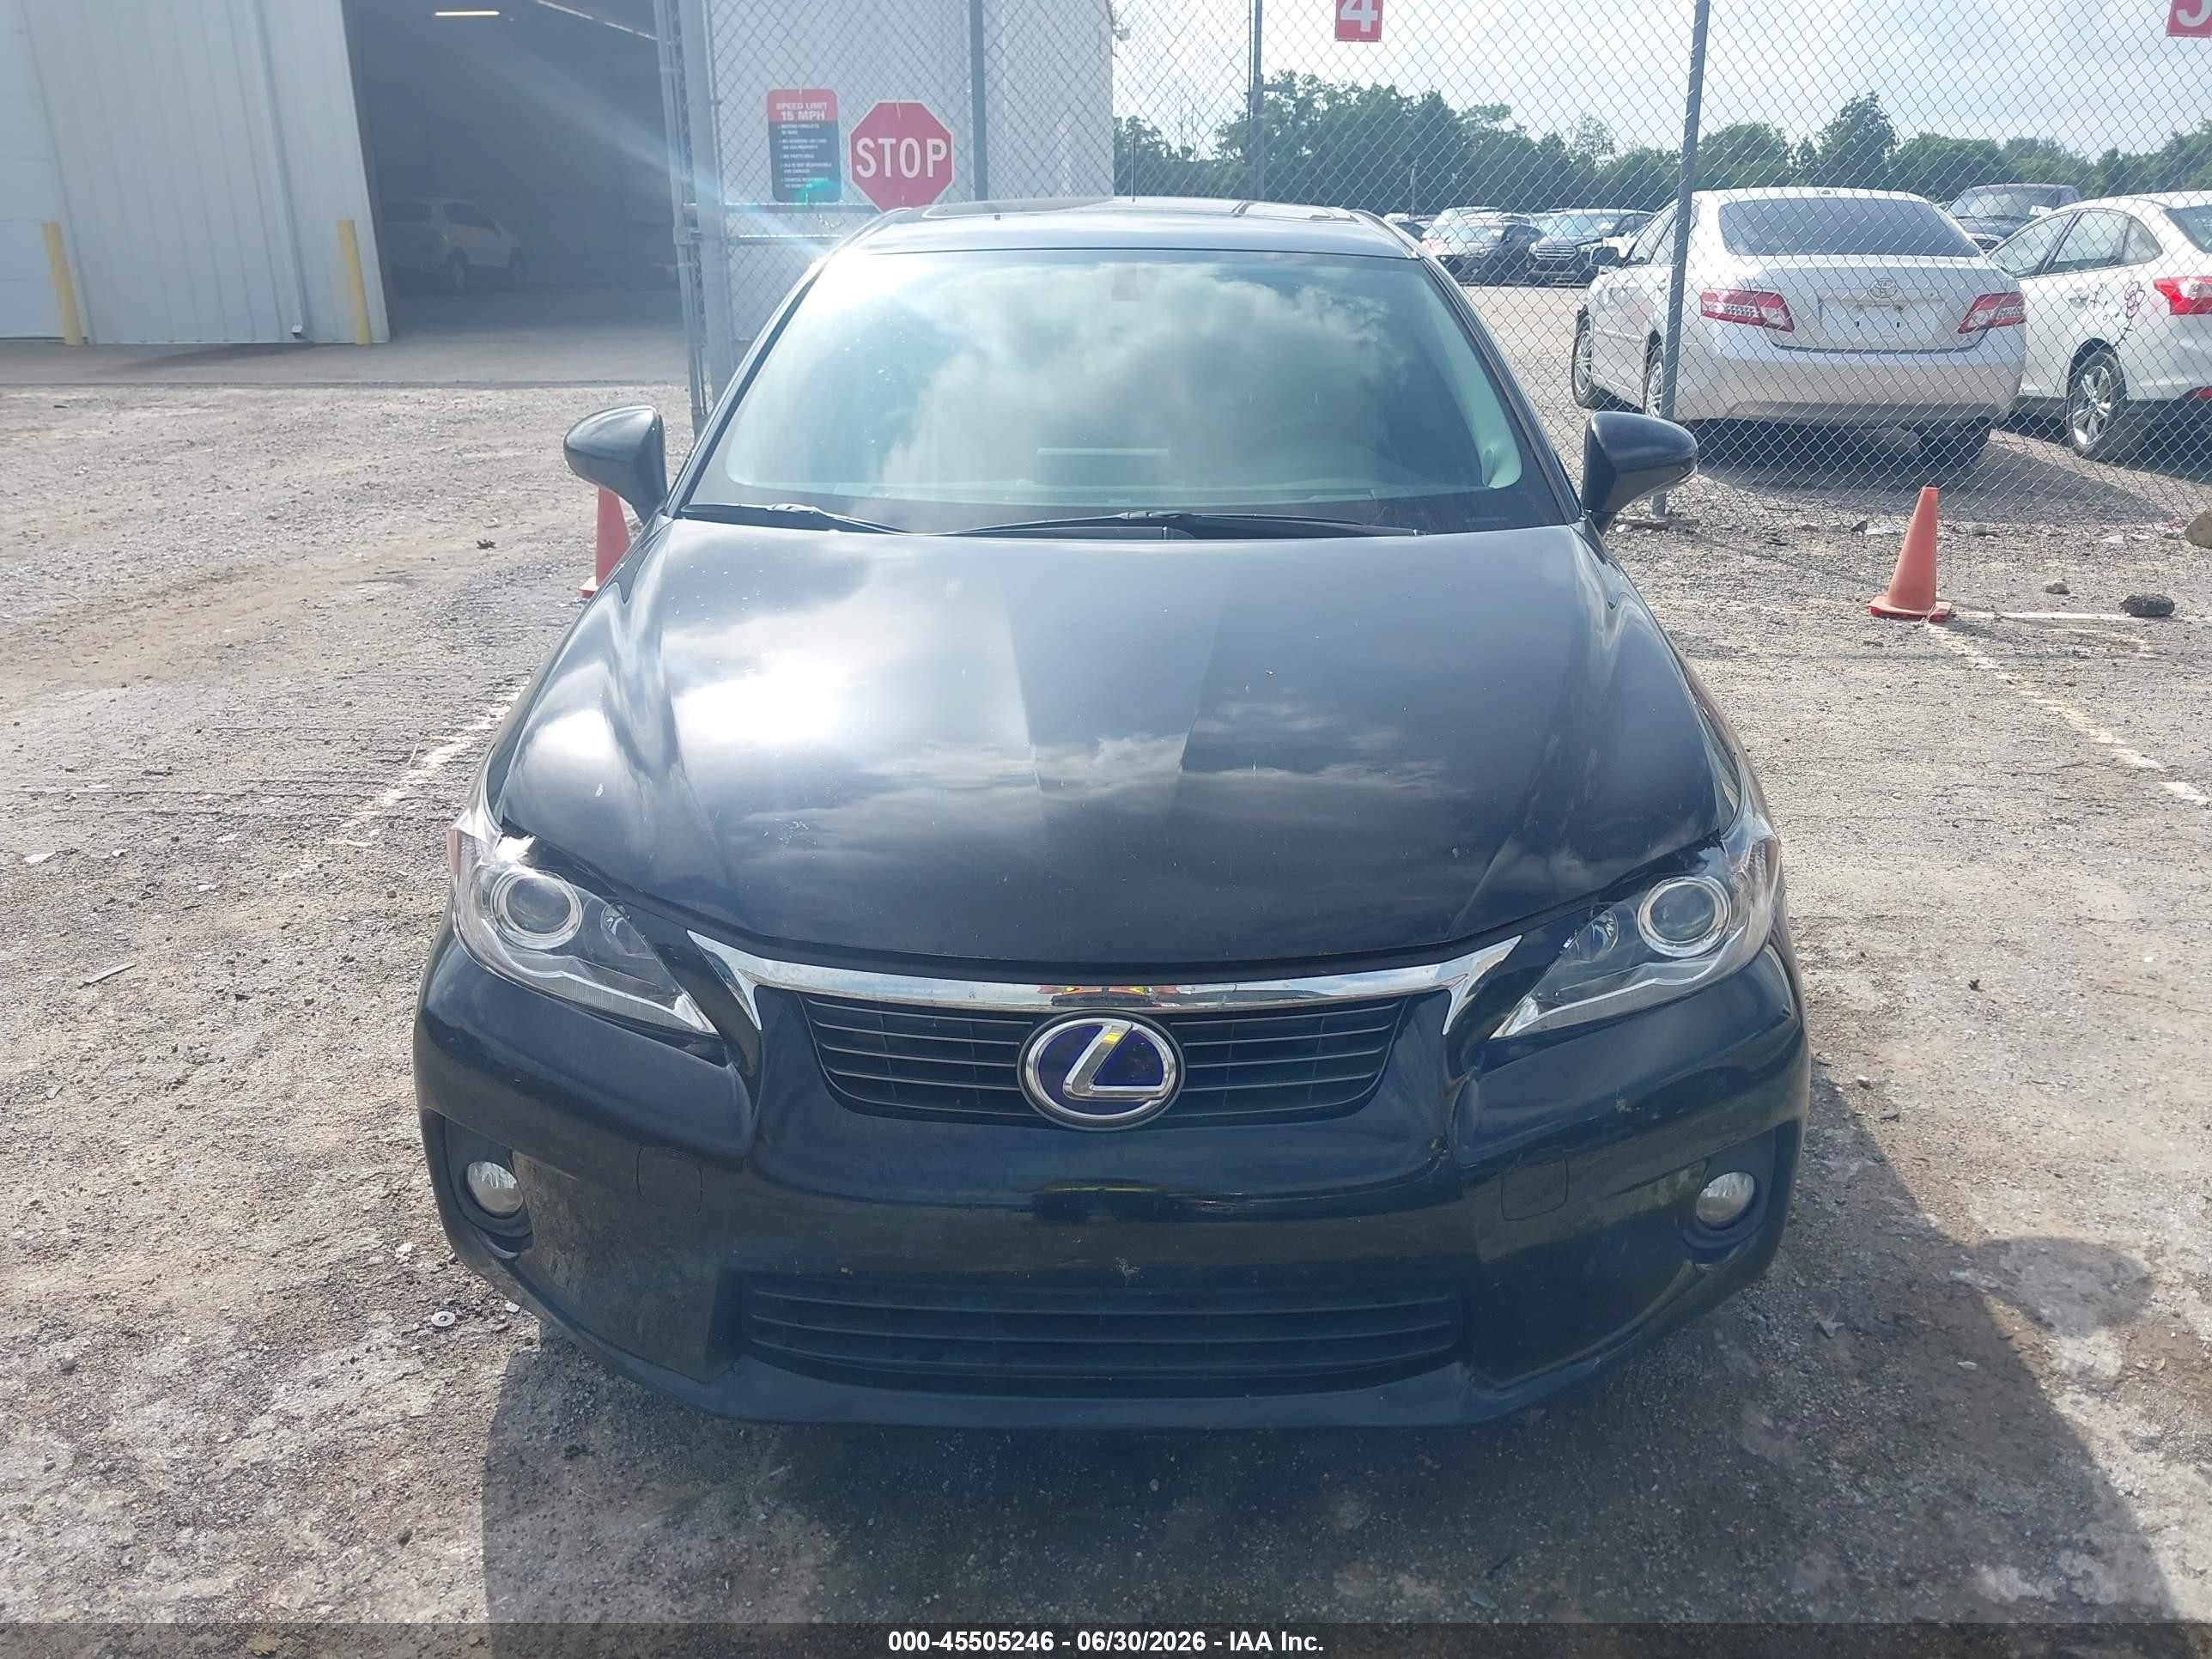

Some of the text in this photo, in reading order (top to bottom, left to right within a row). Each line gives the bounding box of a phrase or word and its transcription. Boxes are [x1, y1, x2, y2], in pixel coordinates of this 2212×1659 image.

[1340, 0, 1378, 32] 4
[775, 102, 827, 111] SPEED LIMIT
[781, 111, 825, 121] 15 MPH
[856, 137, 947, 179] STOP
